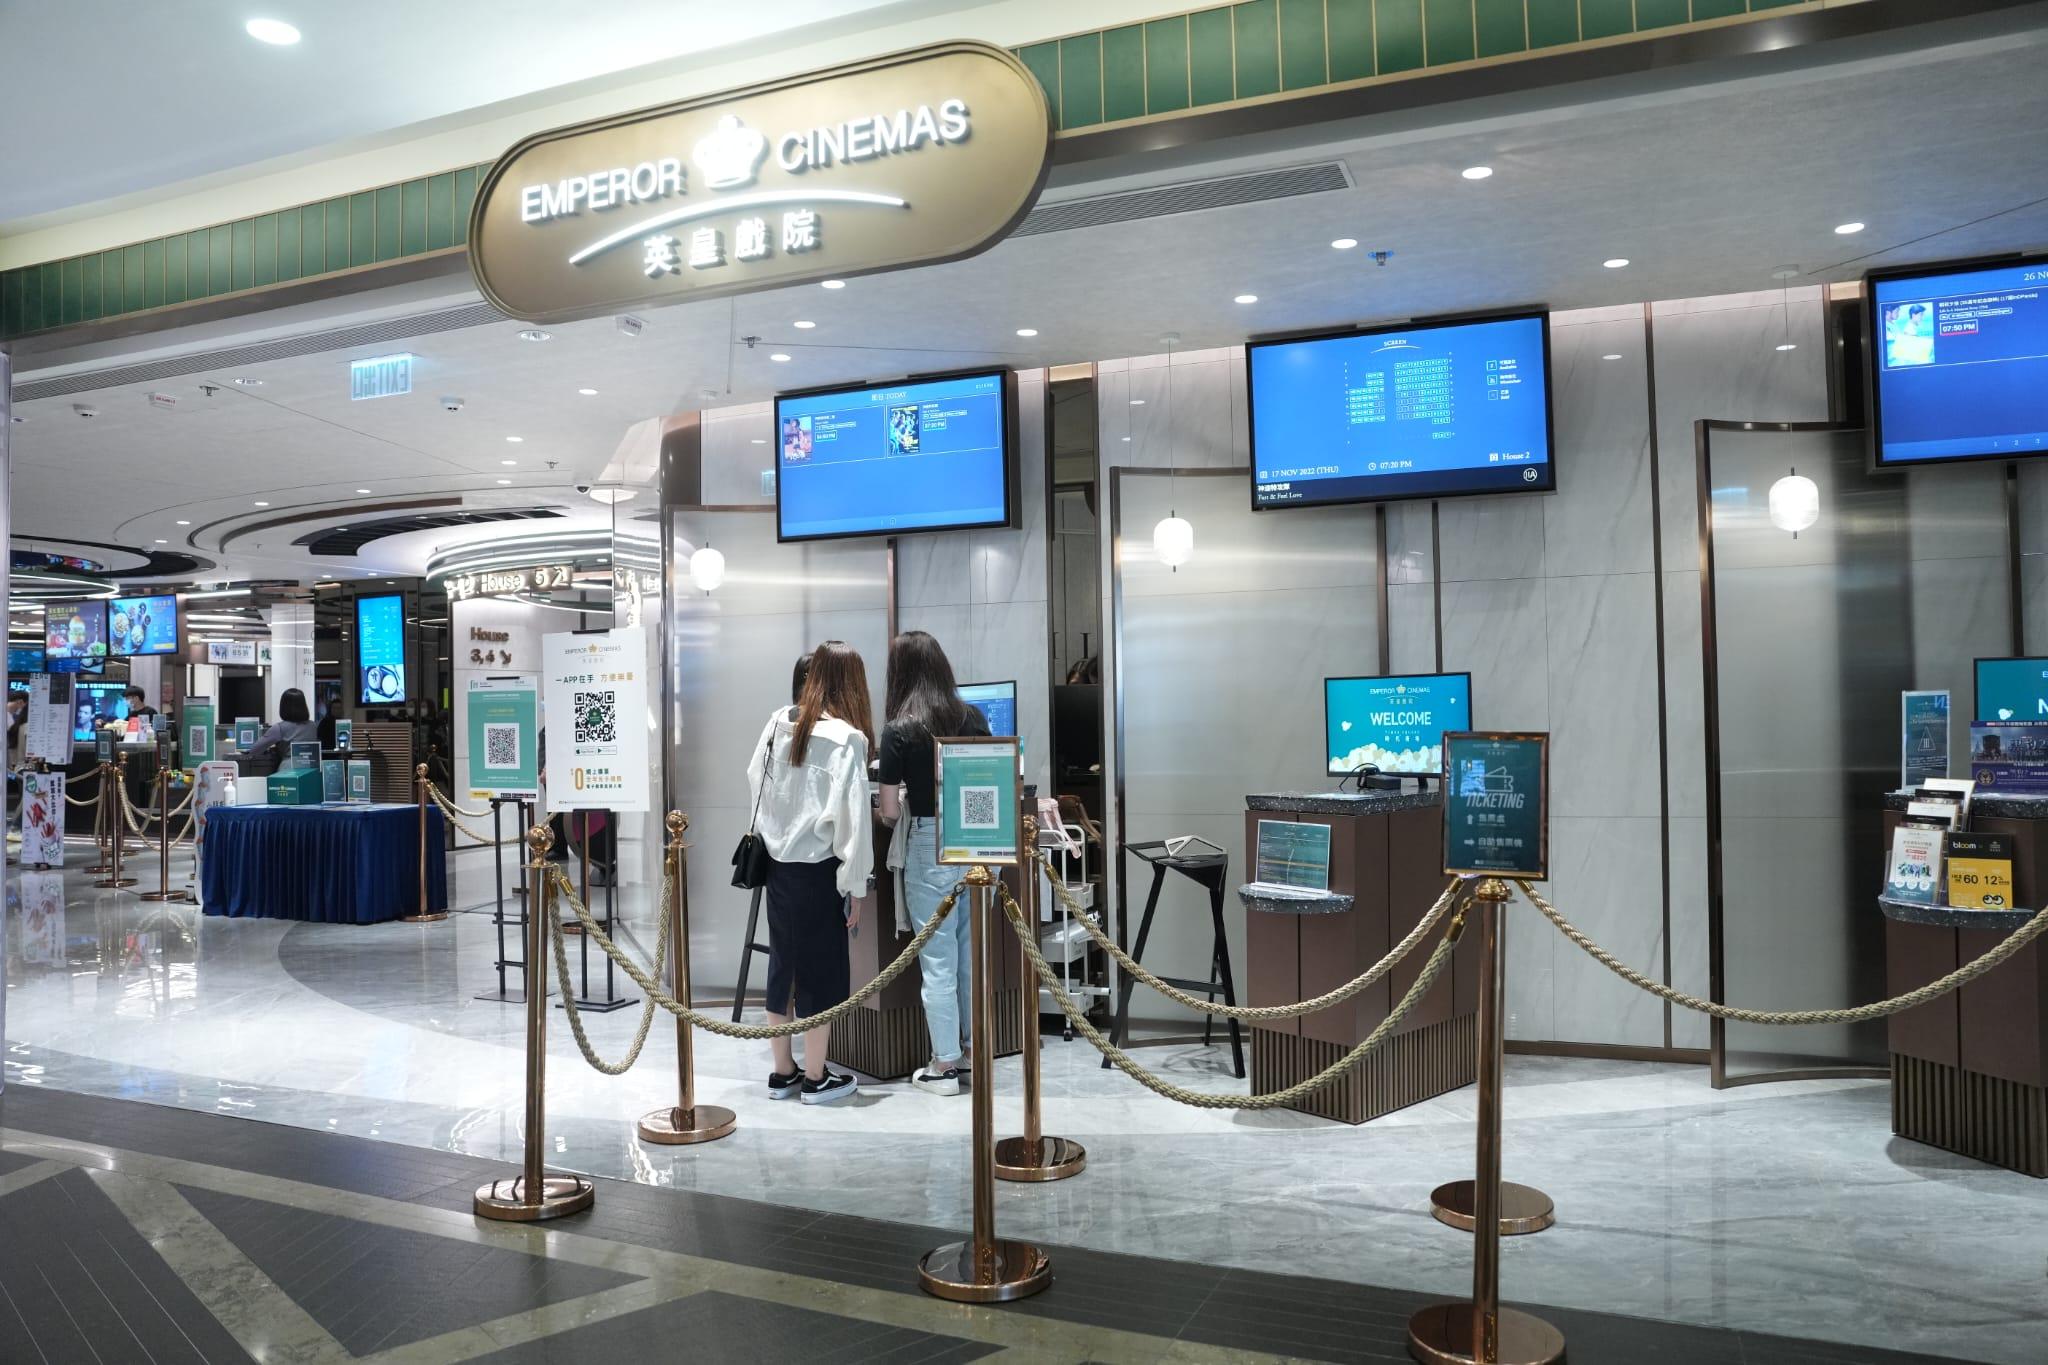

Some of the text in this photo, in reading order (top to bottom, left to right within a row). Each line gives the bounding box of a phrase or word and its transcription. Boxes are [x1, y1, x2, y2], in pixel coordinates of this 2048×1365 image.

[520, 98, 969, 223] EMPEROR CINEMAS
[643, 209, 820, 276] 英皇戲院
[2024, 272, 2035, 281] 26
[1383, 339, 1406, 347] SCREEN
[1502, 451, 1531, 460] House 2
[1399, 460, 1412, 468] PM
[1271, 470, 1279, 478] 17
[1281, 469, 1298, 477] NOV
[481, 572, 522, 593] House
[470, 627, 509, 642] House
[1370, 711, 1432, 726] WELCOME
[1466, 793, 1525, 809] TICKETING
[1952, 841, 1977, 849] bloom
[1963, 874, 1979, 884] 60
[1984, 875, 1998, 885] 12
